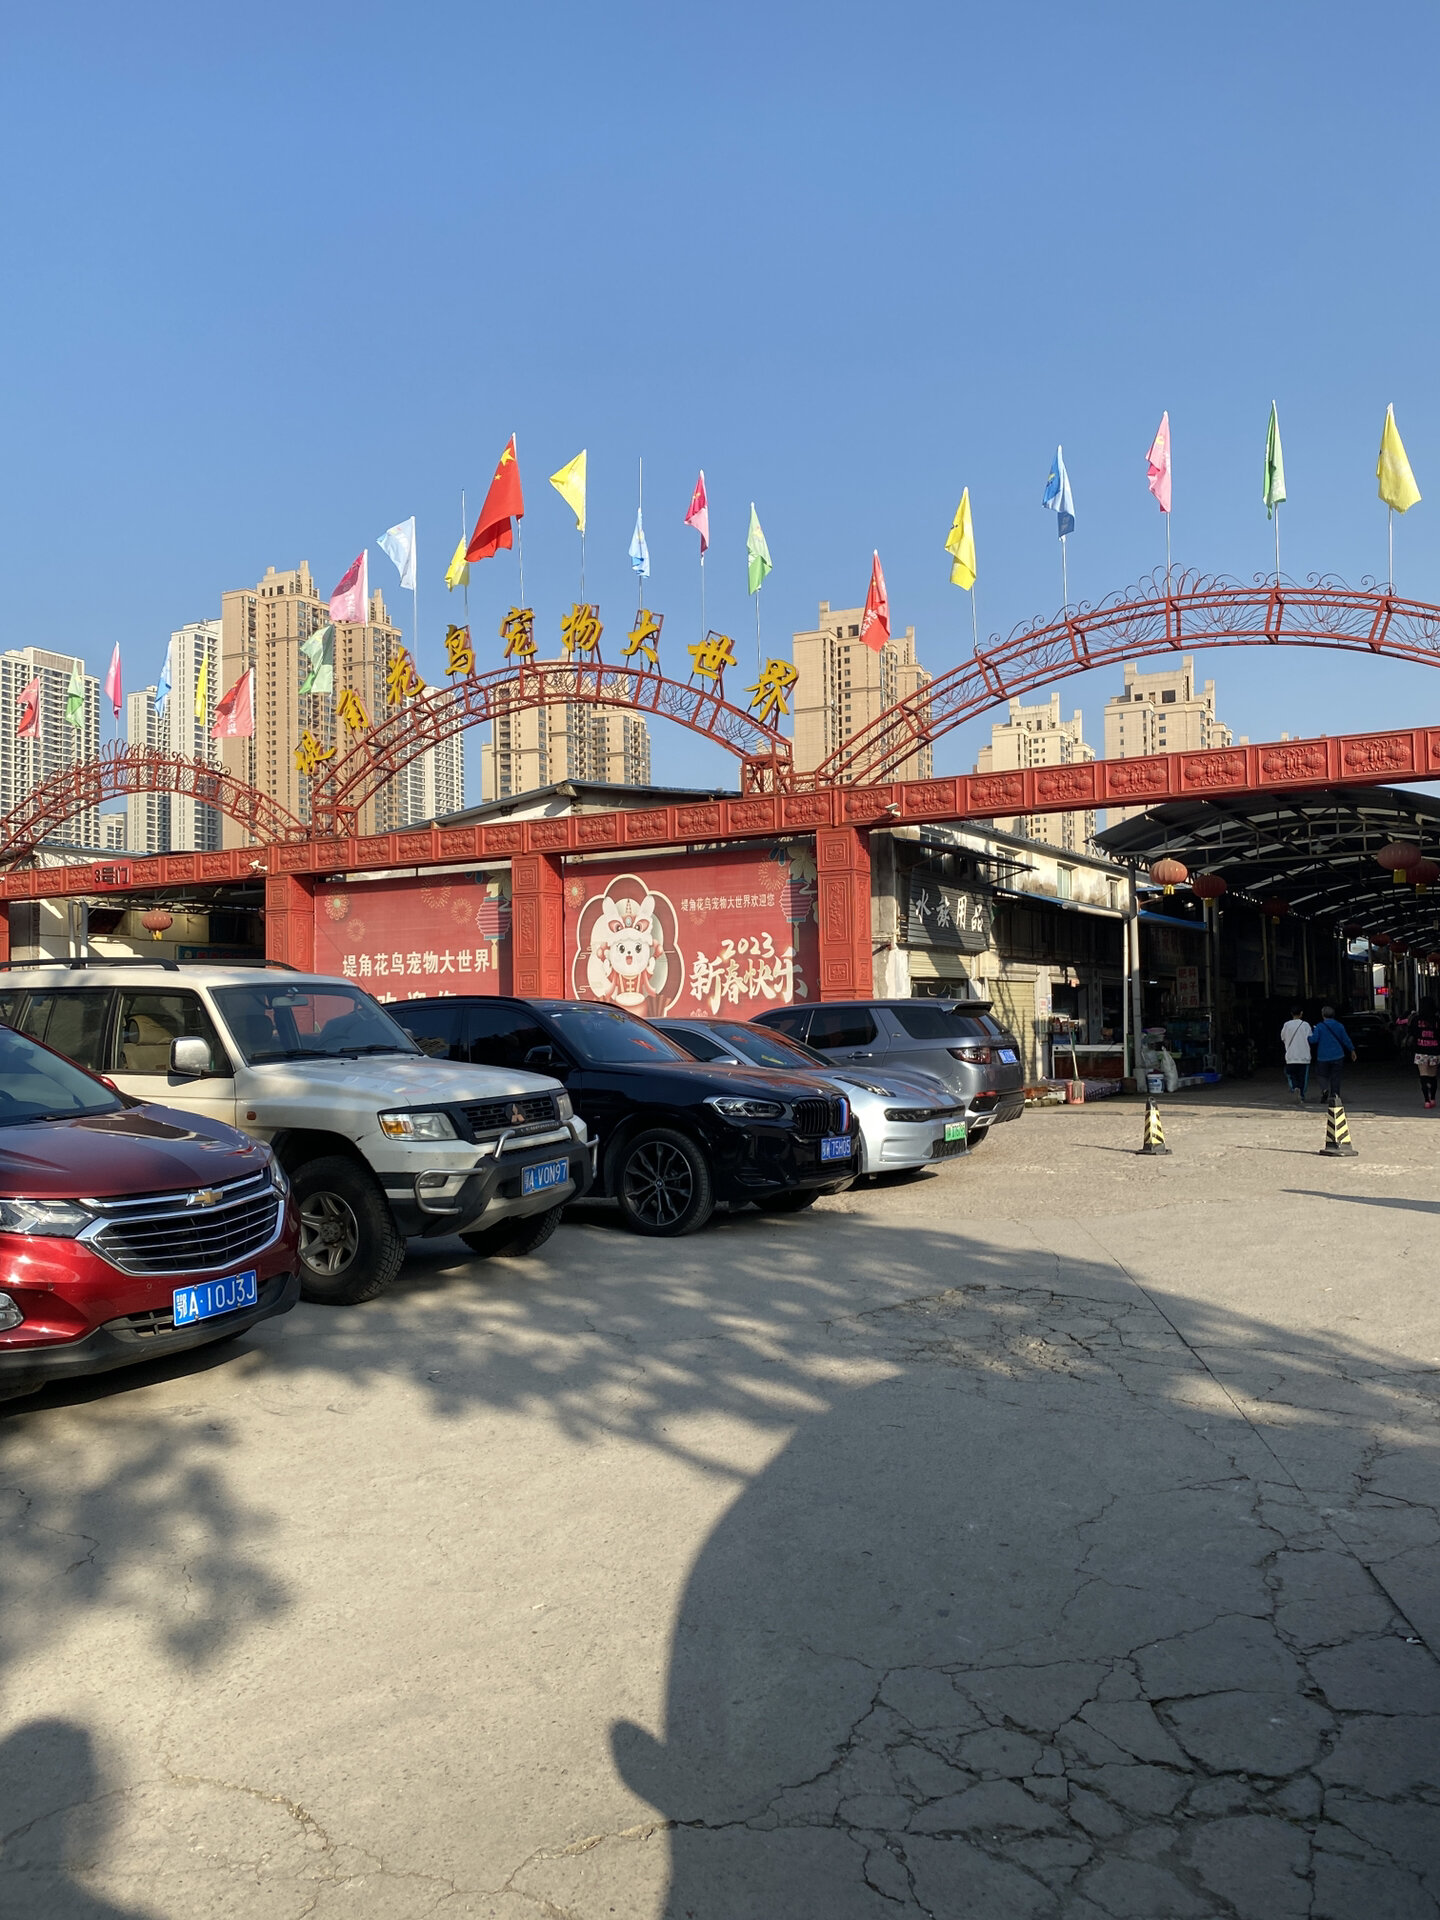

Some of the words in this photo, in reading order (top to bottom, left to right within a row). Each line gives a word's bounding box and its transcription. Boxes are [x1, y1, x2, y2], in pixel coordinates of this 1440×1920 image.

[294, 603, 798, 776] 堤角花鸟宠物大世界
[95, 866, 129, 886] 3号门
[681, 893, 776, 912] 堤角花鸟宠物大世界欢迎您
[915, 888, 984, 932] 水族用品
[721, 931, 776, 961] 2023
[342, 948, 491, 978] 堤角花鸟宠物大世界
[689, 946, 809, 1016] 新春快乐
